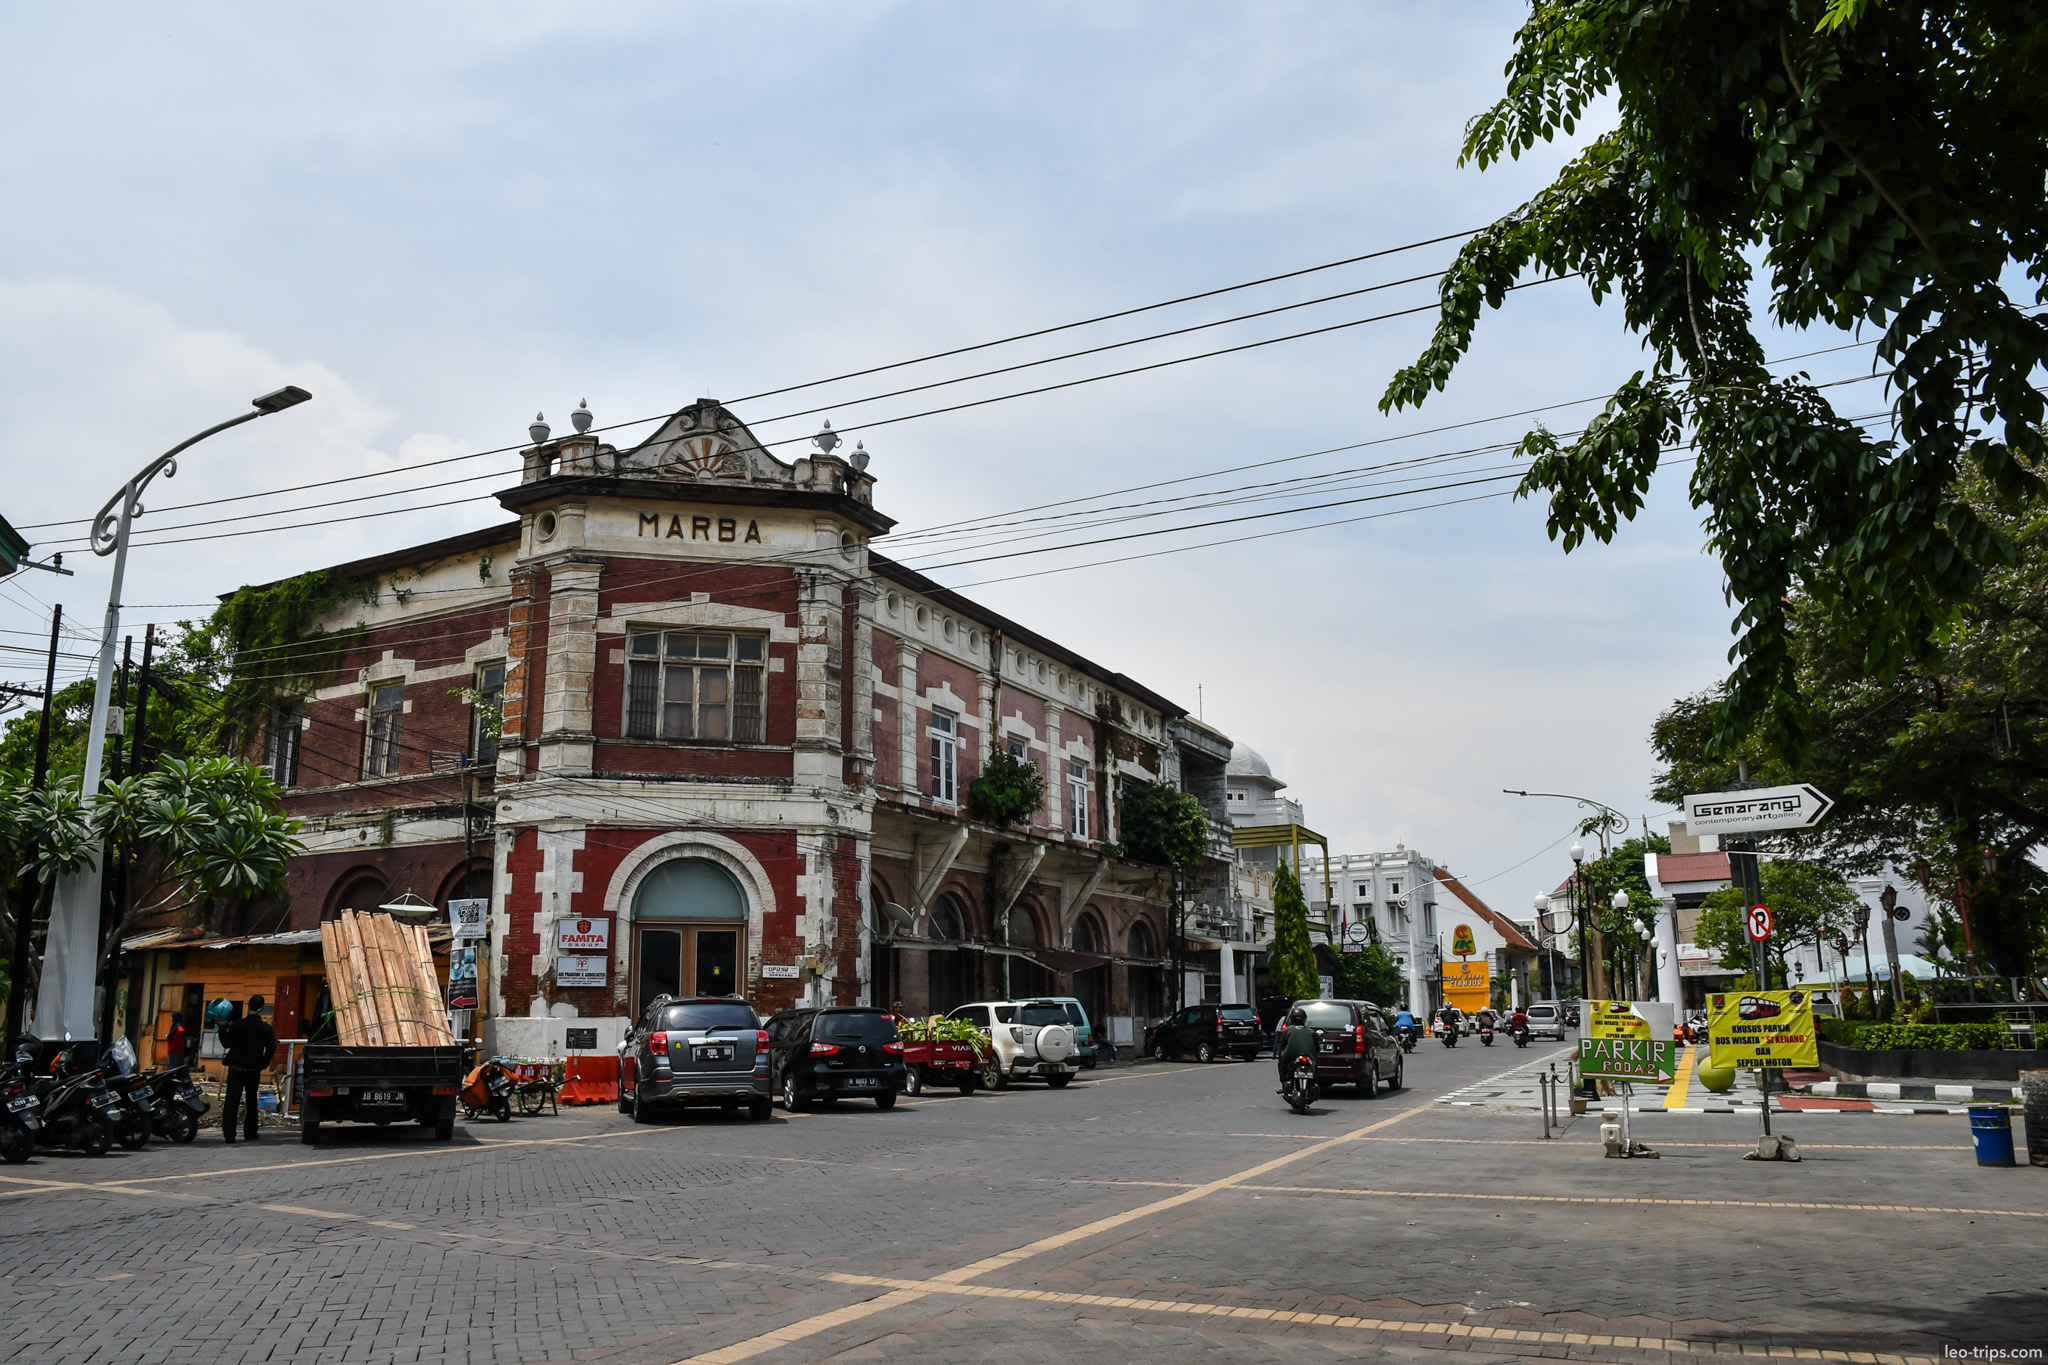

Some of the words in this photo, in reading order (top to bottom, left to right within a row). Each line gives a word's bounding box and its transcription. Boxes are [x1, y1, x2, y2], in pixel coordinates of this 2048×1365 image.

[638, 512, 762, 544] MARBA
[1694, 795, 1801, 817] semarang
[1694, 811, 1803, 826] contemporaryartgallery
[1755, 911, 1766, 934] P
[561, 934, 605, 943] FAMITA
[1454, 939, 1473, 950] IBC
[1732, 1024, 1762, 1033] KHUSUS
[1764, 1024, 1790, 1033] PARKIR
[1715, 1036, 1731, 1045] BUS
[1732, 1036, 1760, 1045] WISATA
[1581, 1039, 1666, 1062] PARKIR
[1755, 1047, 1771, 1056] DAN
[1736, 1058, 1764, 1067] SEPEDA
[1766, 1058, 1792, 1067] MOTOR
[362, 1092, 371, 1100] AB
[374, 1092, 391, 1100] 8619
[395, 1092, 404, 1100] JN
